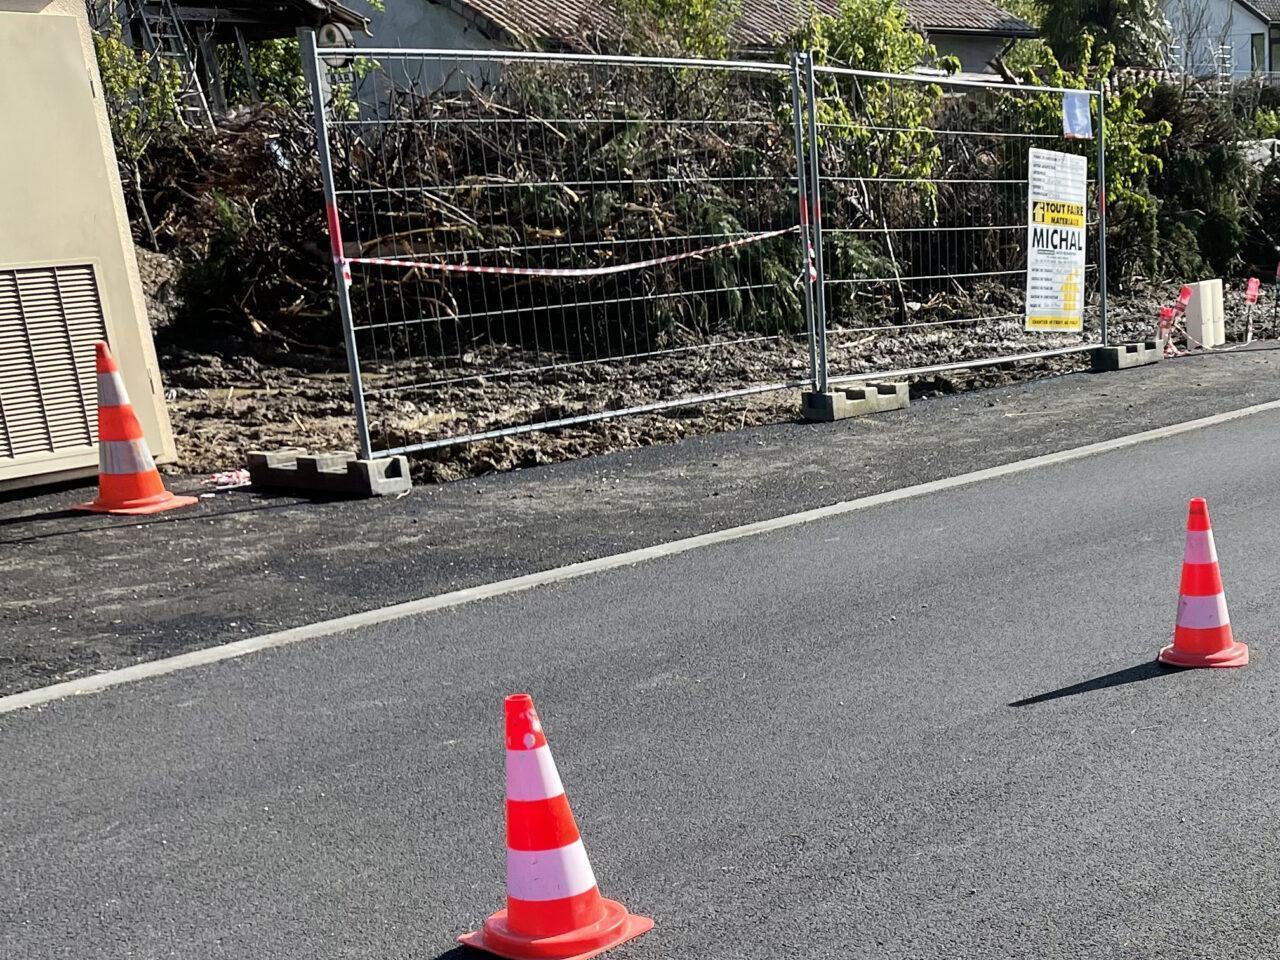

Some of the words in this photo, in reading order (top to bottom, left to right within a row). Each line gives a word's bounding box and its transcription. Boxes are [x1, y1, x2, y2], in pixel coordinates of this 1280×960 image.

[1046, 202, 1066, 214] TOUT
[1067, 205, 1083, 216] FAIRE
[1032, 227, 1083, 251] MICHAL
